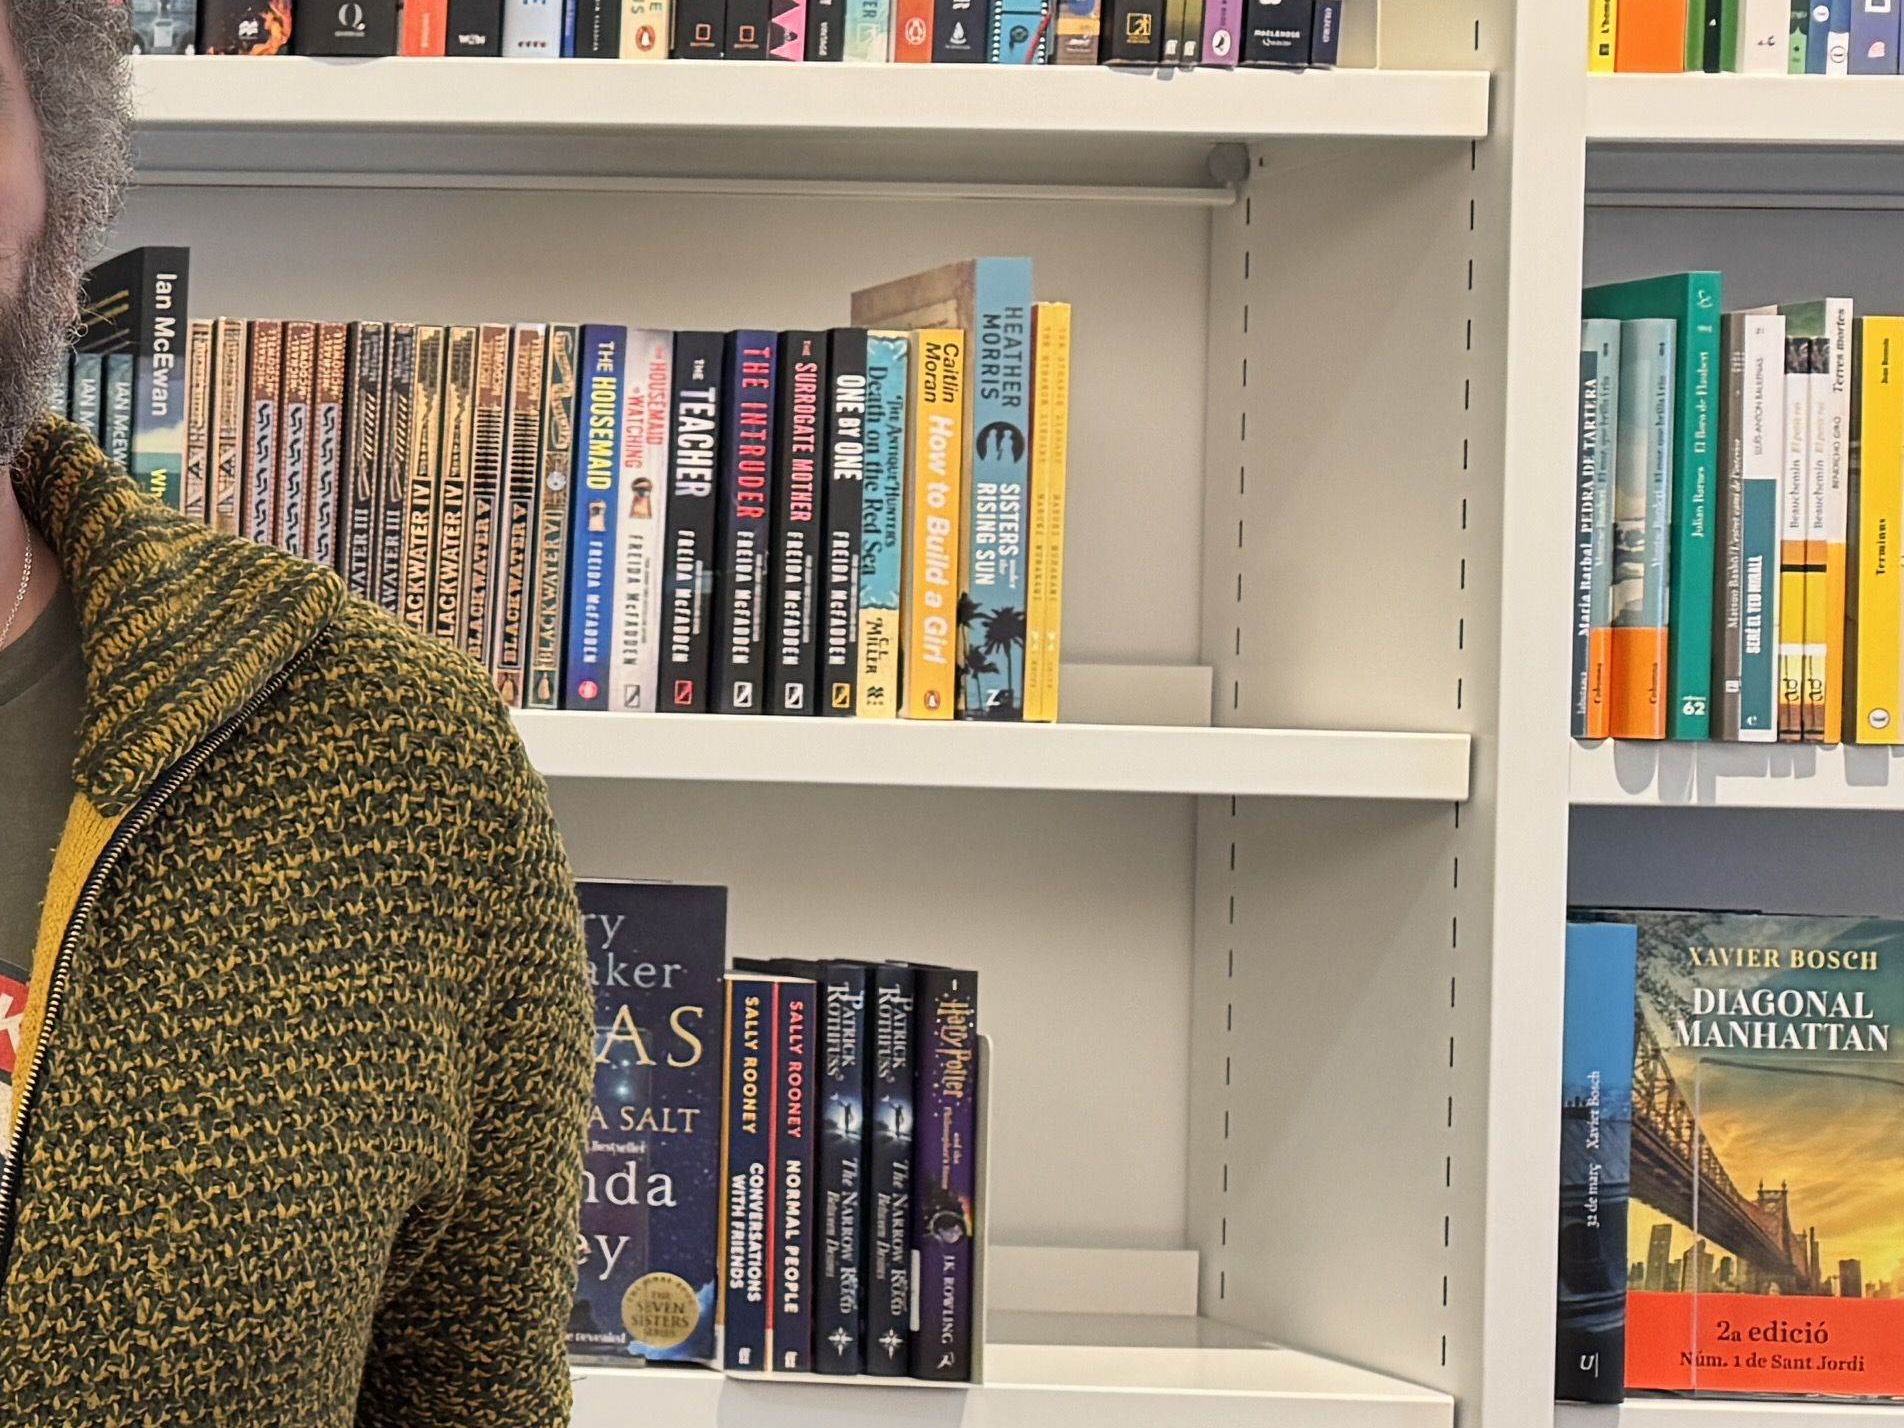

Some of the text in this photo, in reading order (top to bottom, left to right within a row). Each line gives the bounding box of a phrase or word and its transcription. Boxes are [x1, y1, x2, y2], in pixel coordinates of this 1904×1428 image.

[152, 272, 178, 416] Ian McEwan
[586, 341, 617, 490] THE HOUSEMAID
[674, 386, 716, 498] TEACHER
[736, 402, 769, 519] INTRUDER
[833, 374, 866, 482] ONE BY ONE
[676, 529, 695, 583] FREIDA
[922, 414, 953, 665] How to Build a Girl
[1689, 947, 1878, 971] XAVIER BOSCH
[1692, 988, 1874, 1020] DIAGONAL
[742, 996, 759, 1134] SALLY ROONEY
[1676, 1021, 1889, 1052] MANHATTAN
[729, 1173, 746, 1290] WITH FRIENDS
[746, 1161, 764, 1304] CONVERSATIONS
[784, 1159, 801, 1314] NORMAL PEOPLE
[1733, 1353, 1741, 1368] 1
[1746, 1352, 1766, 1369] de
[1771, 1352, 1812, 1370] Sant
[1816, 1353, 1864, 1372] Jordi
[1748, 1321, 1828, 1345] edició
